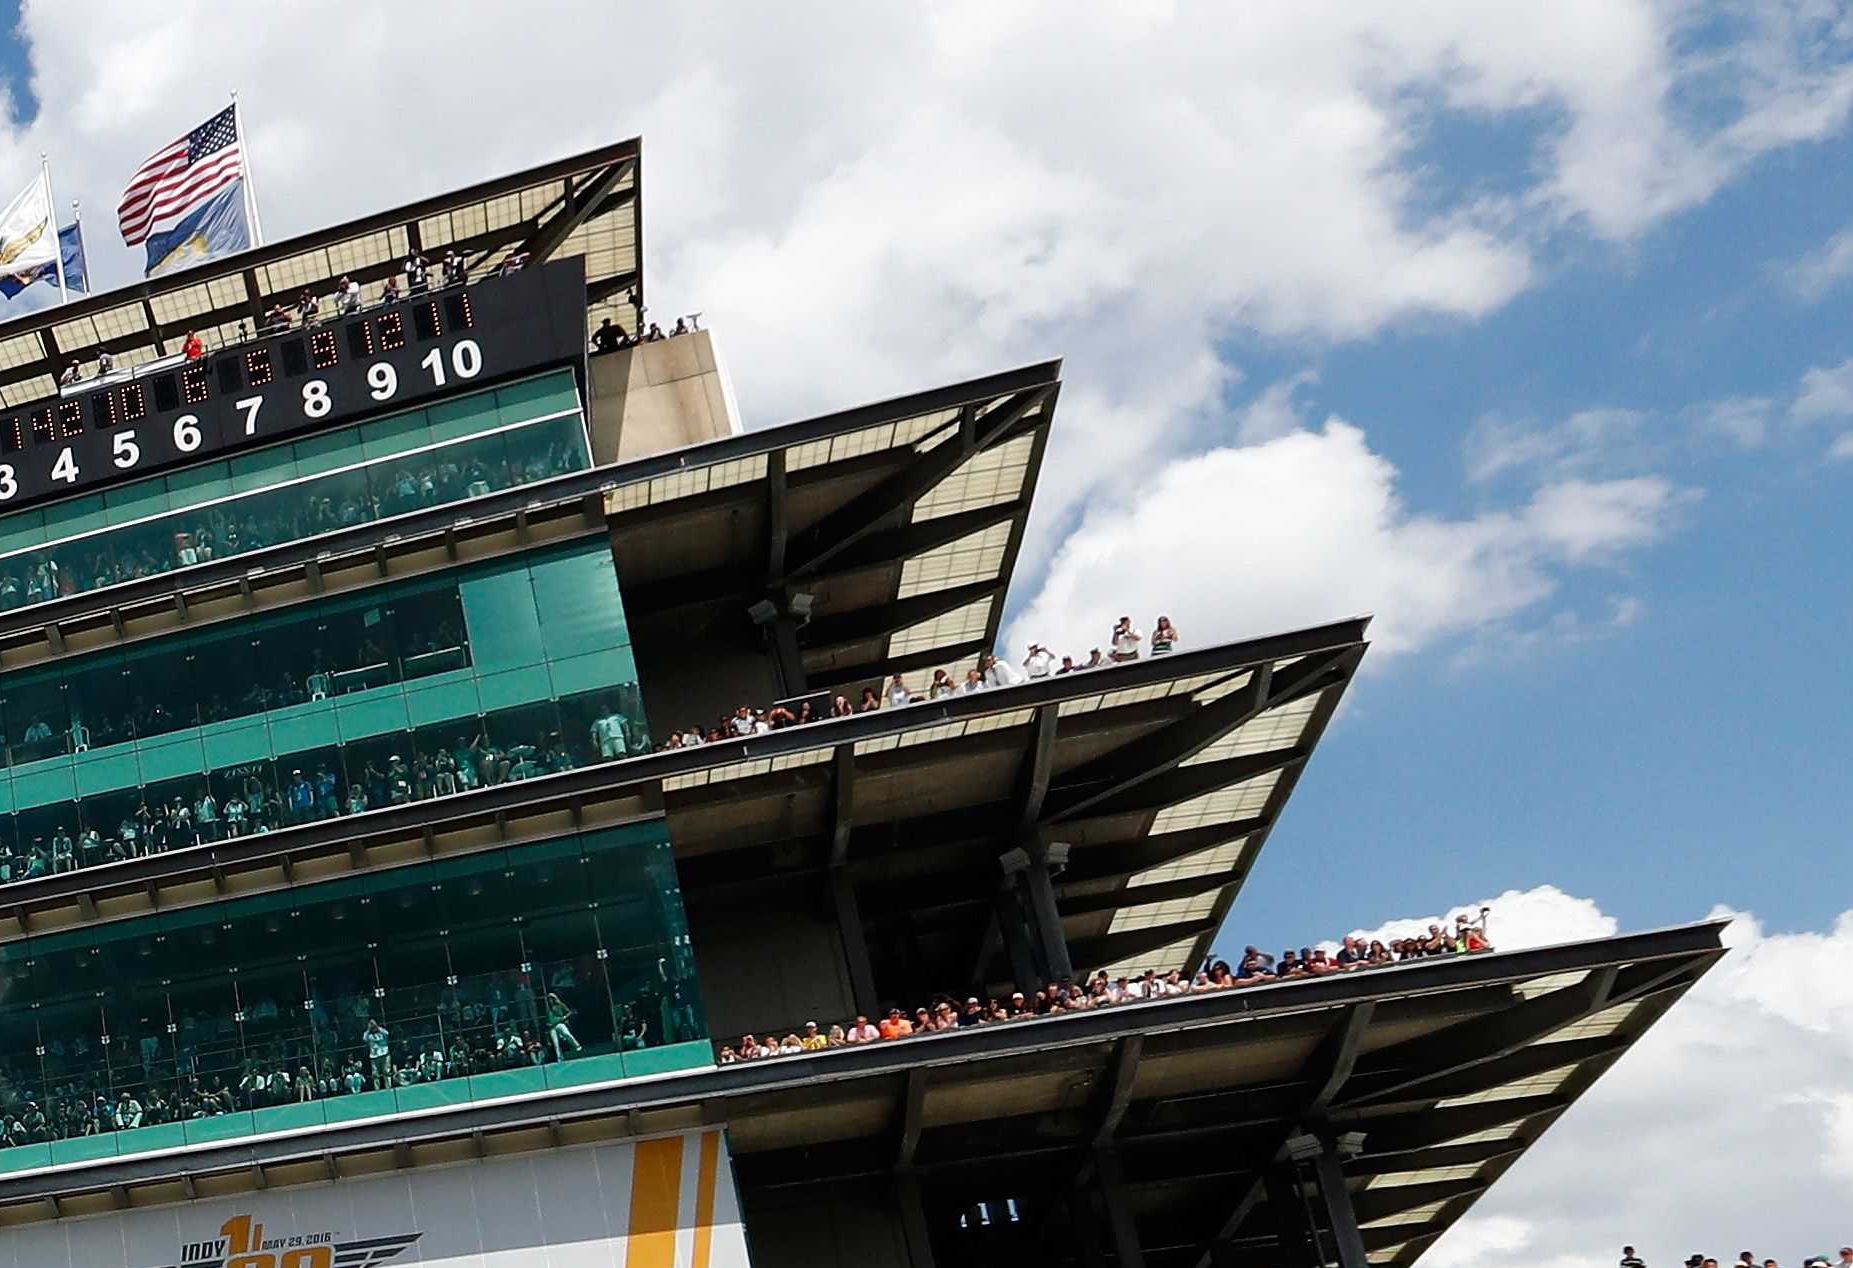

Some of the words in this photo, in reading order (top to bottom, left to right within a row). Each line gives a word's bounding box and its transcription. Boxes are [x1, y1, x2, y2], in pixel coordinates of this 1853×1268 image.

[32, 401, 83, 441] 42
[108, 384, 146, 424] 10
[311, 331, 338, 369] 9
[364, 312, 404, 356] 12
[431, 293, 473, 336] 11
[51, 447, 80, 483] 4
[113, 430, 140, 469] 5
[173, 415, 202, 452] 6
[235, 396, 264, 436] 7
[301, 380, 333, 418] 8
[367, 362, 398, 401] 9
[421, 339, 483, 387] 10
[181, 1239, 226, 1262] INDY
[307, 1232, 332, 1245] 2016
